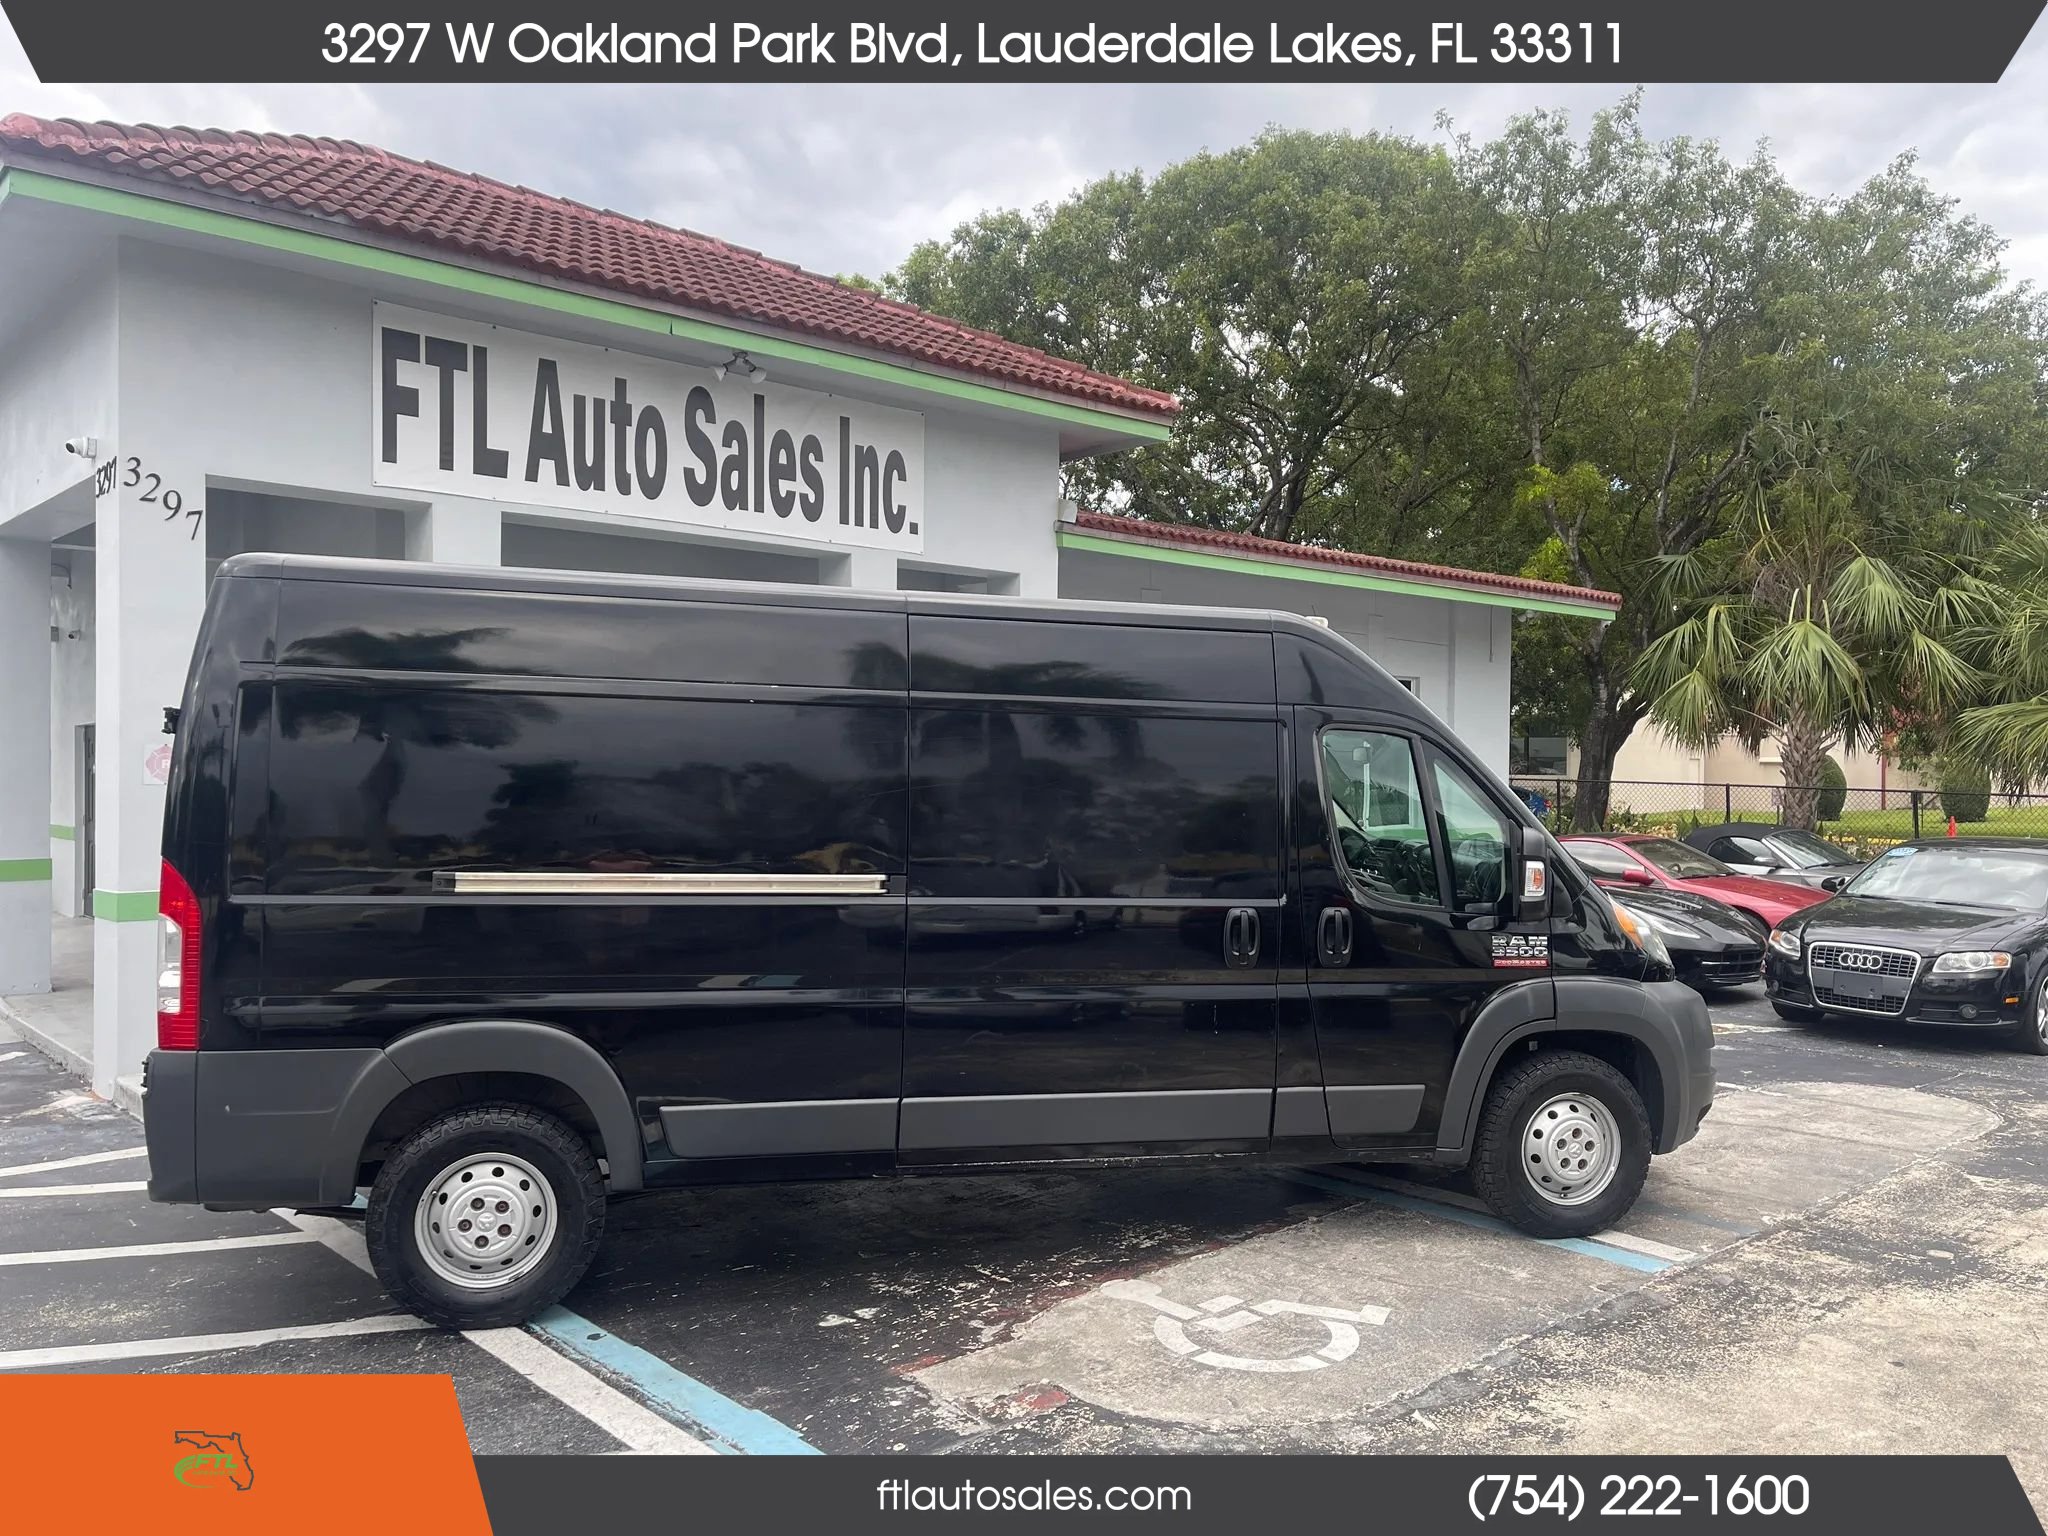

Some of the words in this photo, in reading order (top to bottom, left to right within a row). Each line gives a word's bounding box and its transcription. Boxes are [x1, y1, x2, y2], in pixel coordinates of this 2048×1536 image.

[381, 326, 509, 479] FTL
[525, 357, 668, 500] Auto
[683, 385, 824, 522] Sales
[838, 415, 919, 535] Inc.
[96, 455, 117, 499] 3297
[122, 456, 204, 541] 3297
[1491, 935, 1548, 947] RAM
[1491, 946, 1549, 958] 3500
